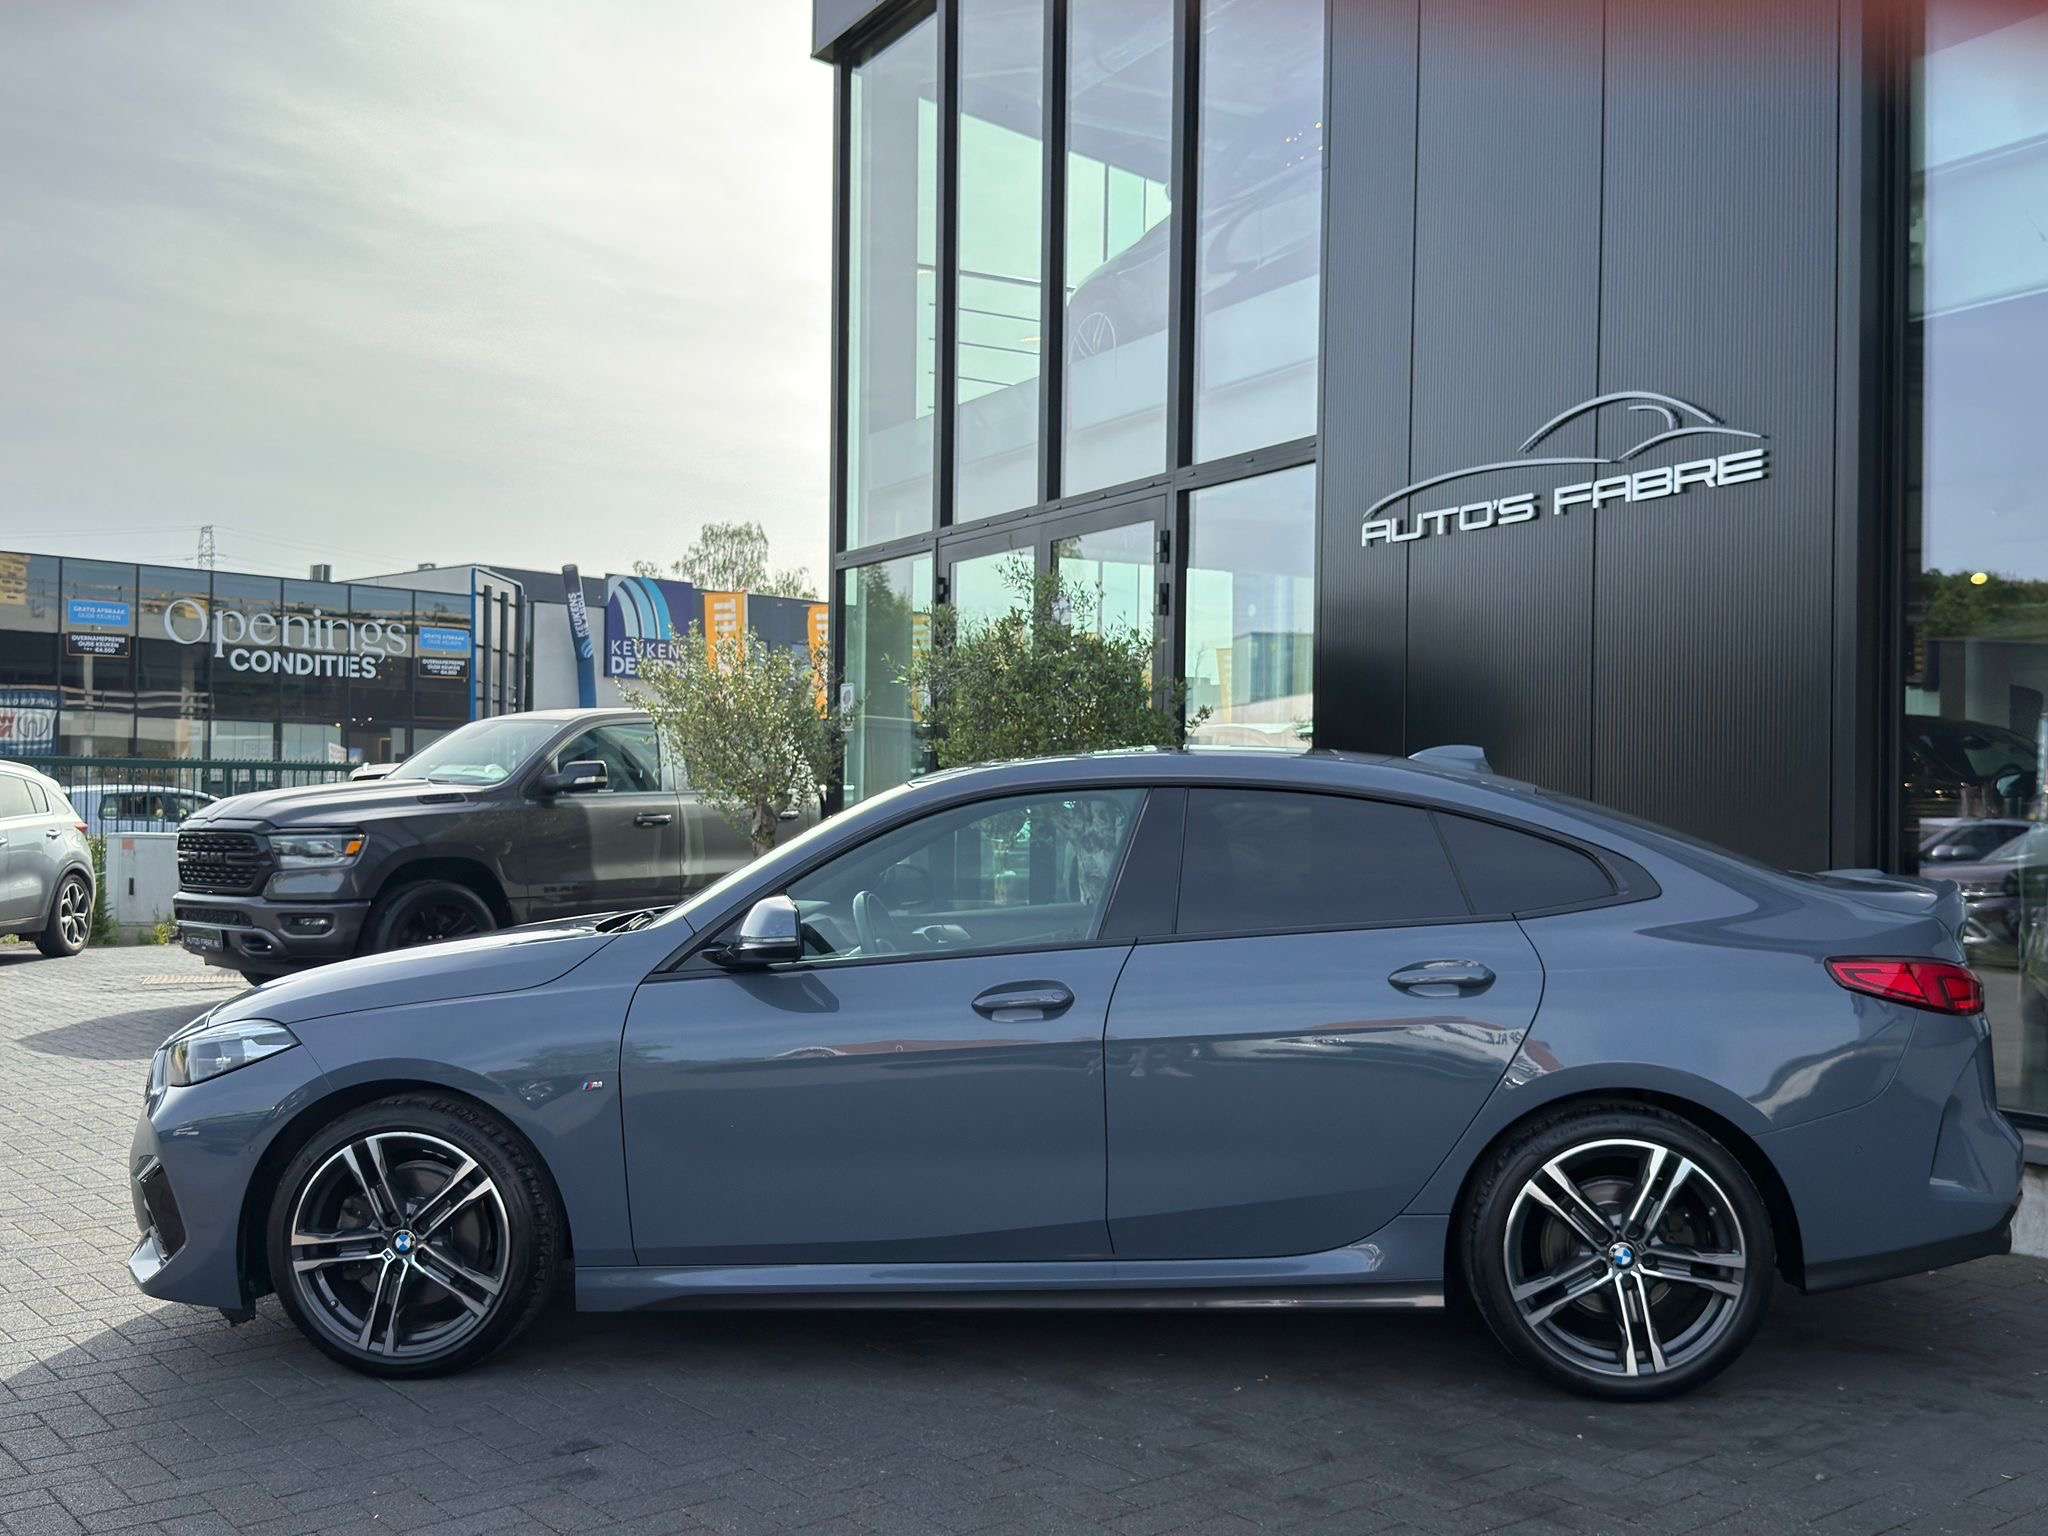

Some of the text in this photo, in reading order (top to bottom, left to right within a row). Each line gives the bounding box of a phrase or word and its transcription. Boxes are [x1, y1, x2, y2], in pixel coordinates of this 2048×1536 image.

[1361, 448, 1766, 548] AUTO'S FABRE
[164, 599, 407, 664] Openings
[568, 592, 586, 638] KEUKENS
[229, 649, 377, 680] CONDITIES
